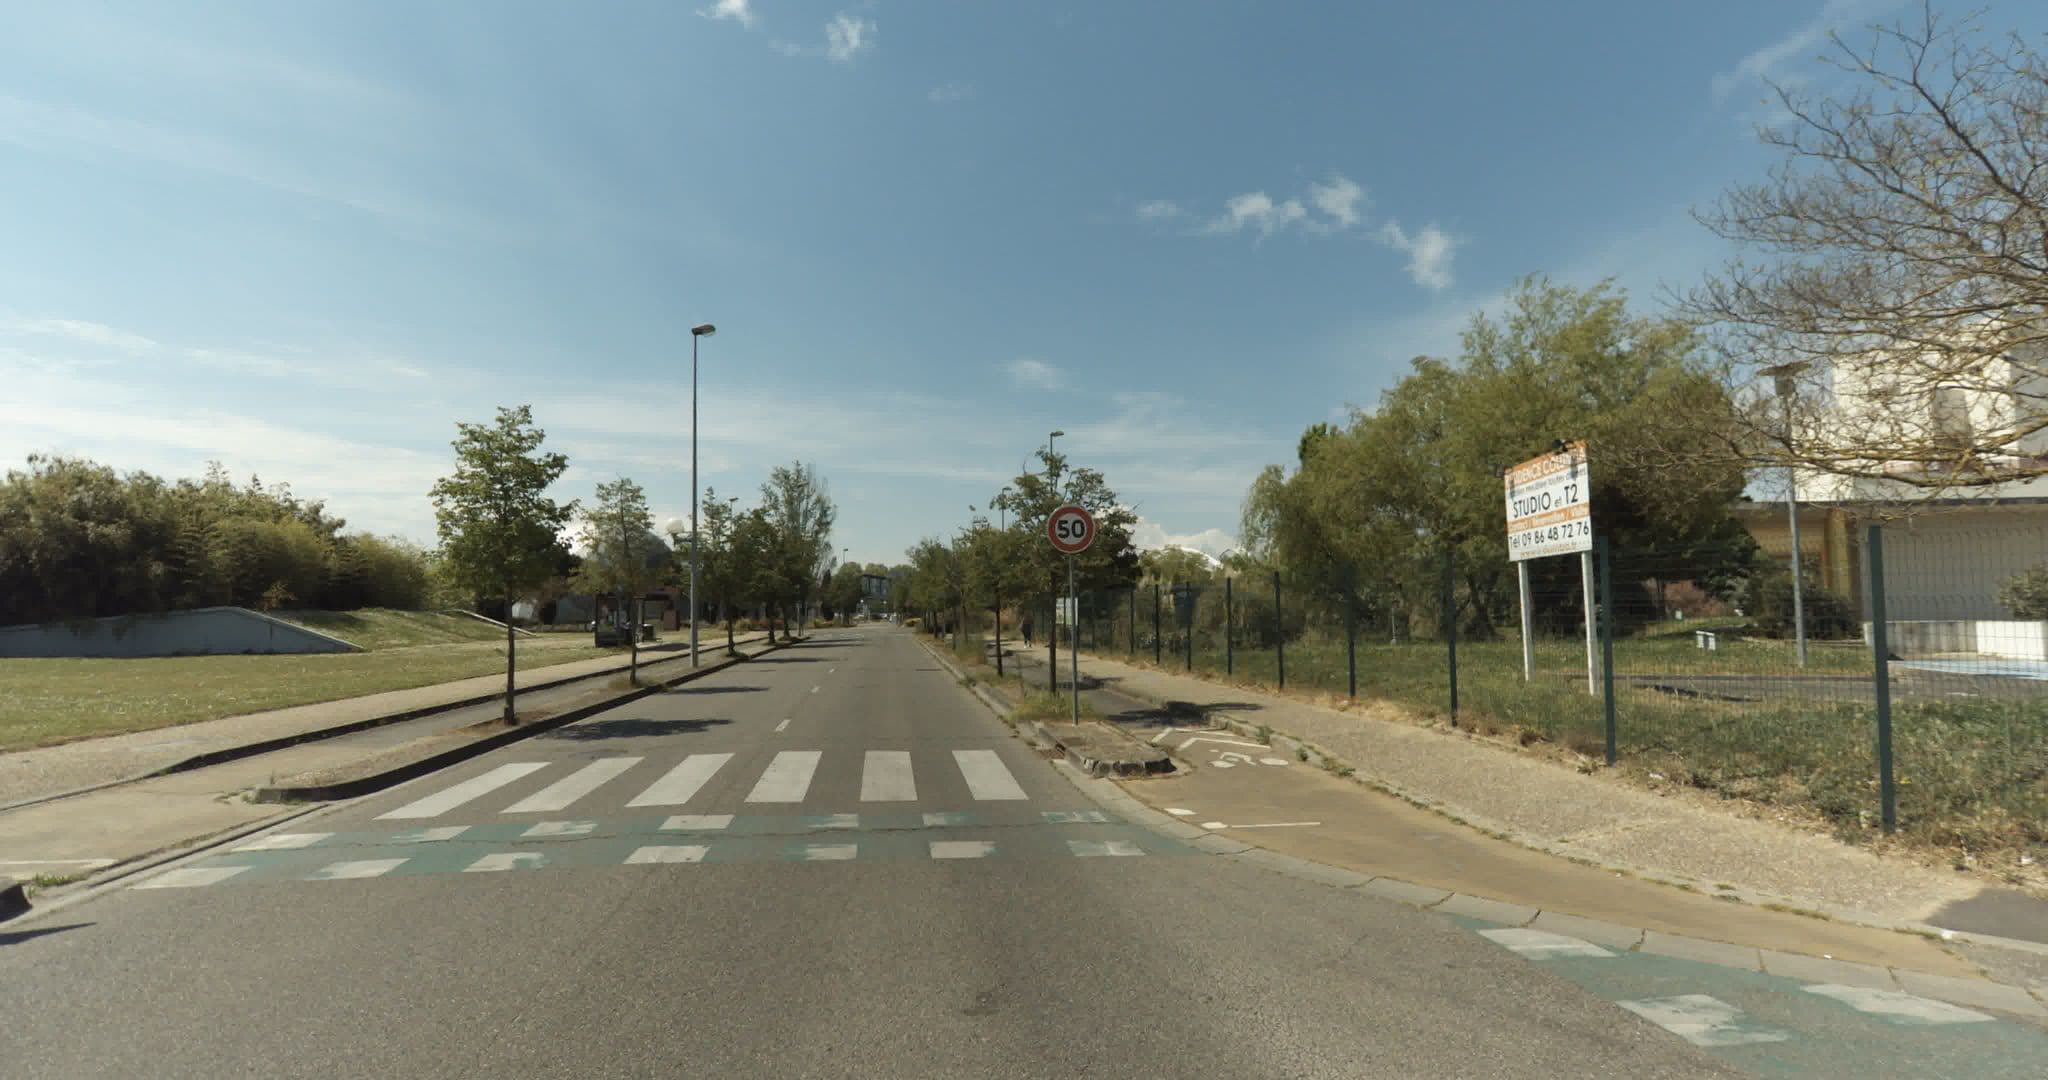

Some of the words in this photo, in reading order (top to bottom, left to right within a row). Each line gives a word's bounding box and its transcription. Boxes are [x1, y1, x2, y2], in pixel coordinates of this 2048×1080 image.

[1513, 492, 1551, 518] STUDIO
[1554, 496, 1562, 507] et
[1564, 484, 1578, 504] T2
[1057, 519, 1086, 539] 50
[1522, 532, 1532, 546] 09
[1534, 530, 1545, 544] 86
[1547, 527, 1559, 541] 48
[1562, 523, 1573, 538] 72
[1577, 521, 1589, 535] 76
